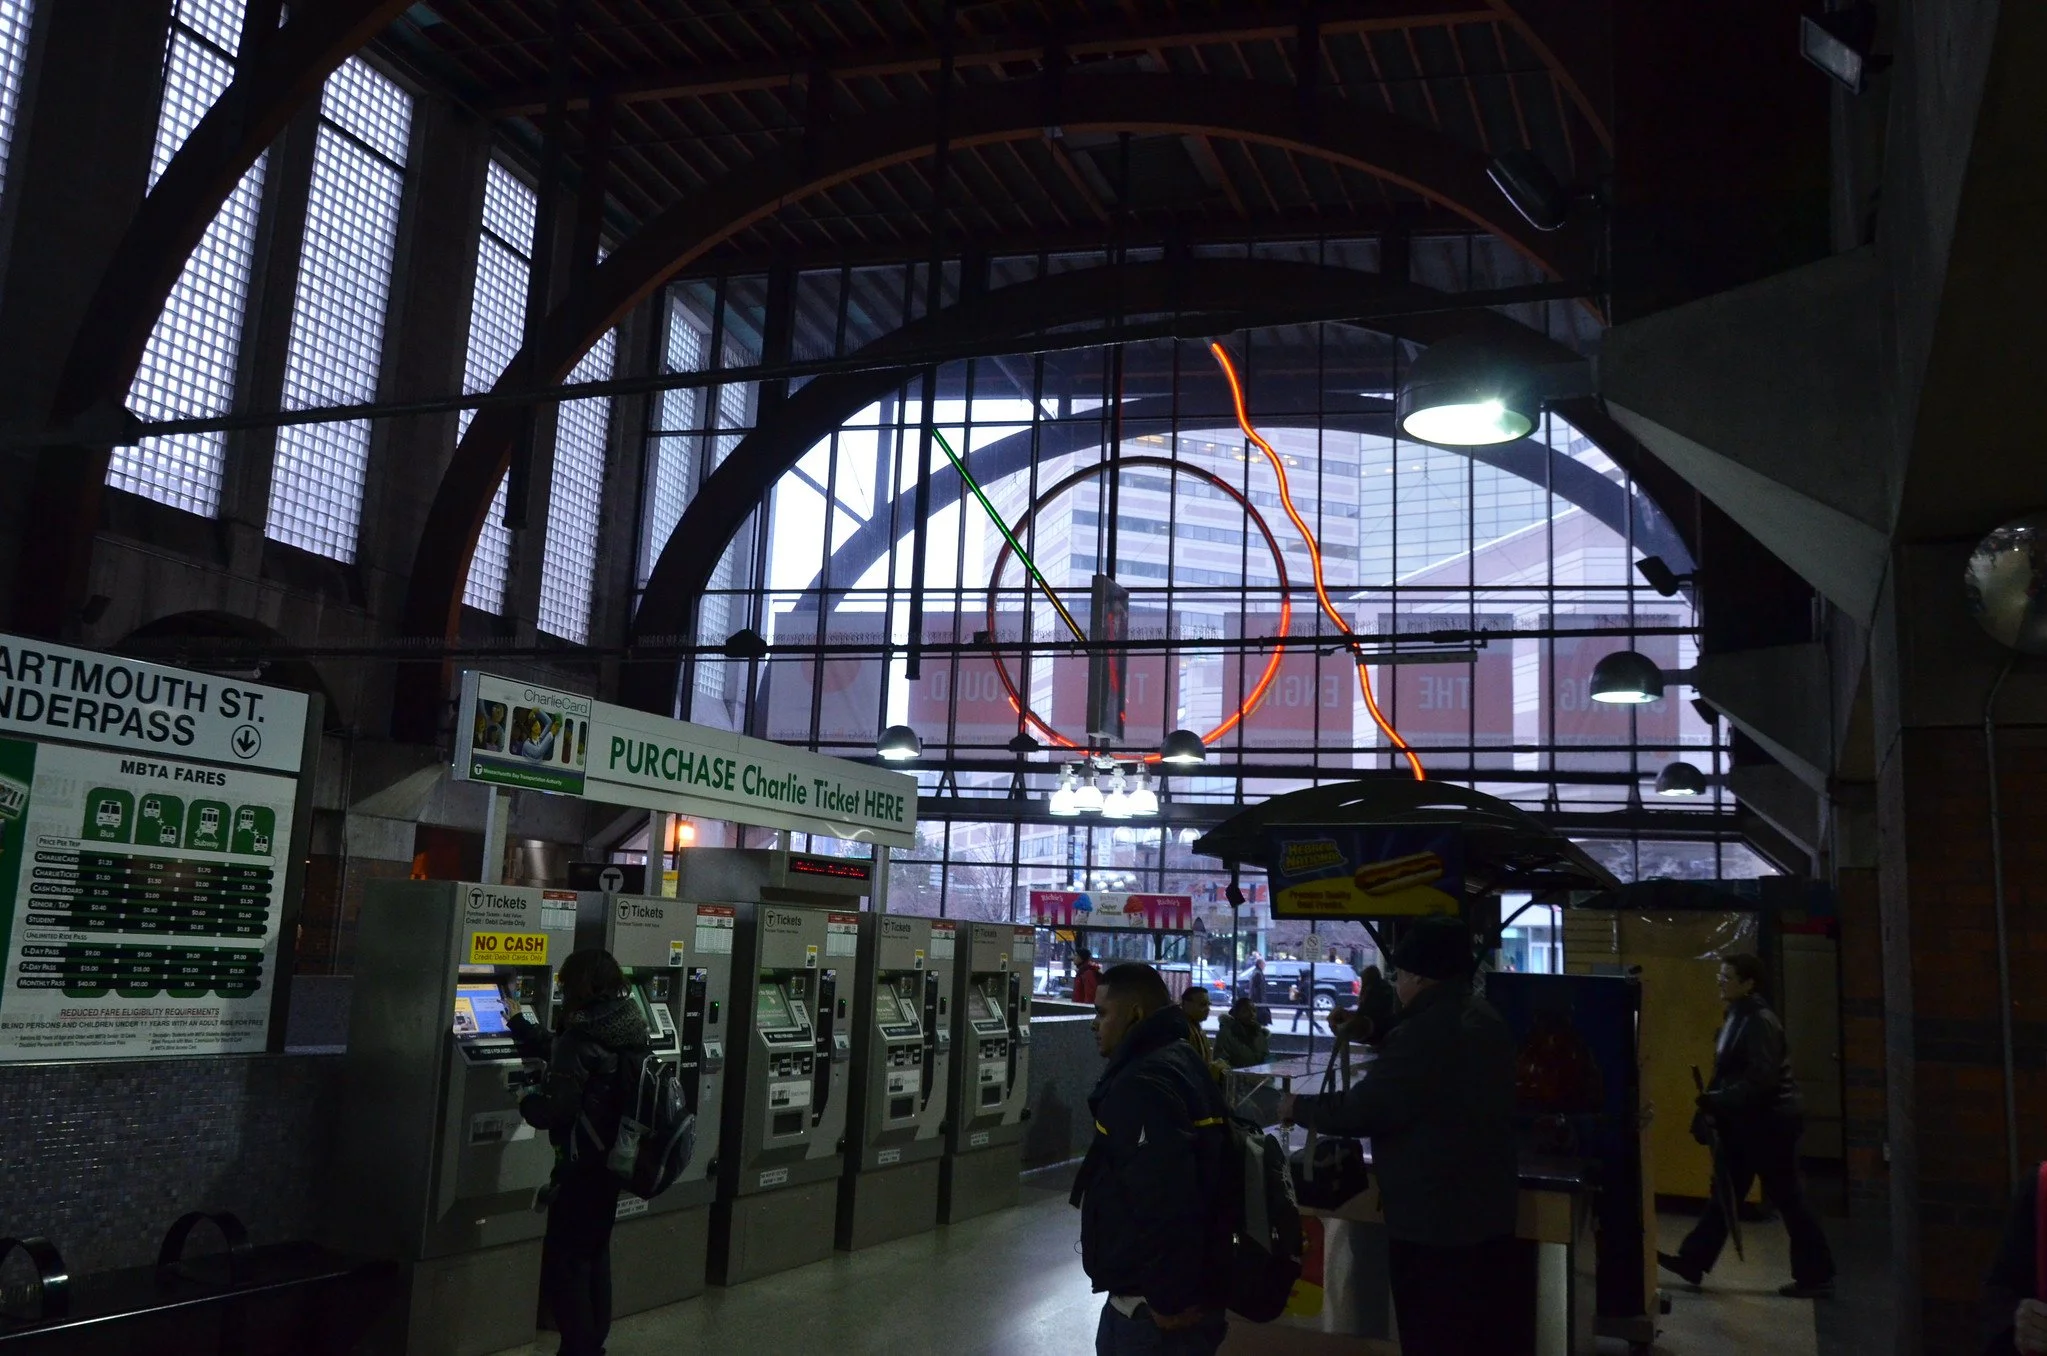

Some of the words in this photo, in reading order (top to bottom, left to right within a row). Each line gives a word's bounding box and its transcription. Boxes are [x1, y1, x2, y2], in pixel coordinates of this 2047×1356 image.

[219, 688, 264, 723] ST.
[524, 689, 588, 714] CharlieCard
[120, 760, 169, 780] MBTA
[174, 768, 226, 787] FARES
[609, 735, 735, 790] PURCHASE
[742, 765, 807, 805] Charlie
[814, 779, 861, 814] Ticket
[864, 789, 904, 822] HERE
[100, 829, 115, 839] Bus
[58, 839, 68, 847] PER
[193, 839, 219, 850] Subway
[486, 894, 527, 910] Tickets
[632, 905, 664, 919] Tickets
[776, 914, 802, 927] Tickets
[891, 921, 911, 932] Tickets
[475, 936, 498, 951] NO
[504, 936, 545, 952] CASH
[24, 947, 44, 955] 1-DAY
[474, 953, 492, 961] Credit
[494, 953, 510, 961] Debit
[530, 954, 543, 962] Only
[20, 980, 50, 988] MONTHLY
[50, 980, 66, 988] PASS
[61, 1009, 99, 1017] REDUCED
[122, 1008, 164, 1016] ELIGIBILITY
[165, 1008, 220, 1016] REQUIREMENTS
